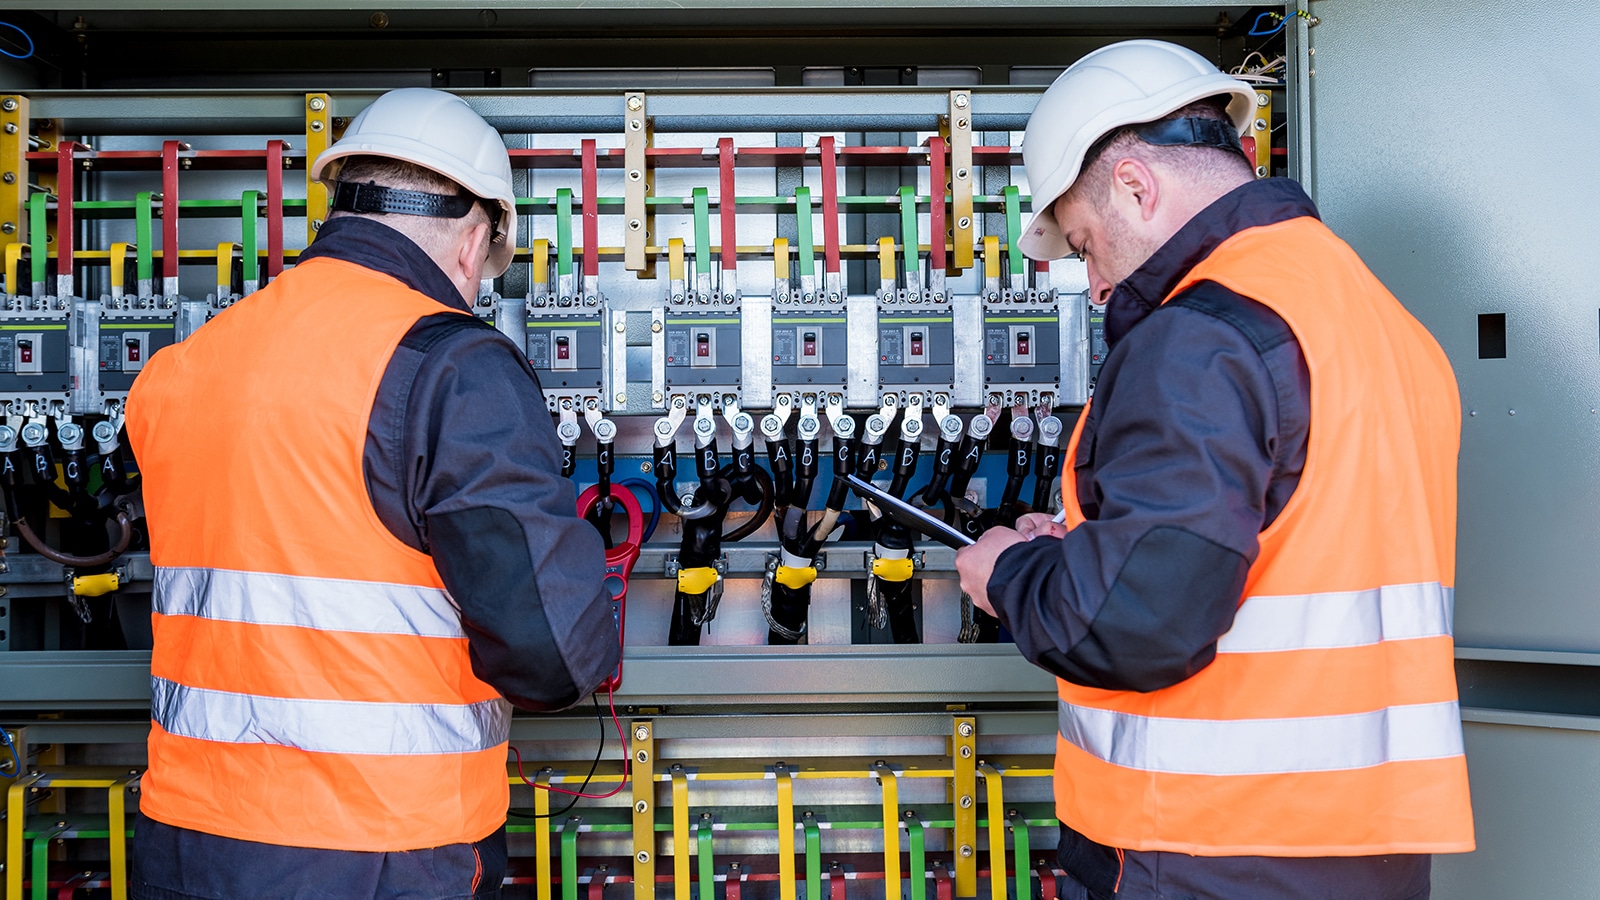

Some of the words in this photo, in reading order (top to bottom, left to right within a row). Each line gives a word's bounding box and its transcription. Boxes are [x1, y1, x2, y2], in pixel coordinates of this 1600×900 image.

[600, 451, 608, 464] C
[656, 450, 674, 470] A
[704, 450, 716, 471] B
[738, 452, 750, 469] C
[774, 446, 787, 462] A
[802, 447, 813, 466] B
[838, 446, 849, 461] C
[863, 448, 876, 464] A
[902, 447, 914, 467] B
[940, 448, 951, 465] C
[966, 445, 979, 463] A
[1017, 450, 1027, 466] B
[1044, 454, 1055, 468] C
[3, 456, 15, 474] A
[35, 453, 47, 473] B
[67, 461, 78, 478] C
[103, 456, 114, 473] A
[966, 520, 977, 533] C
